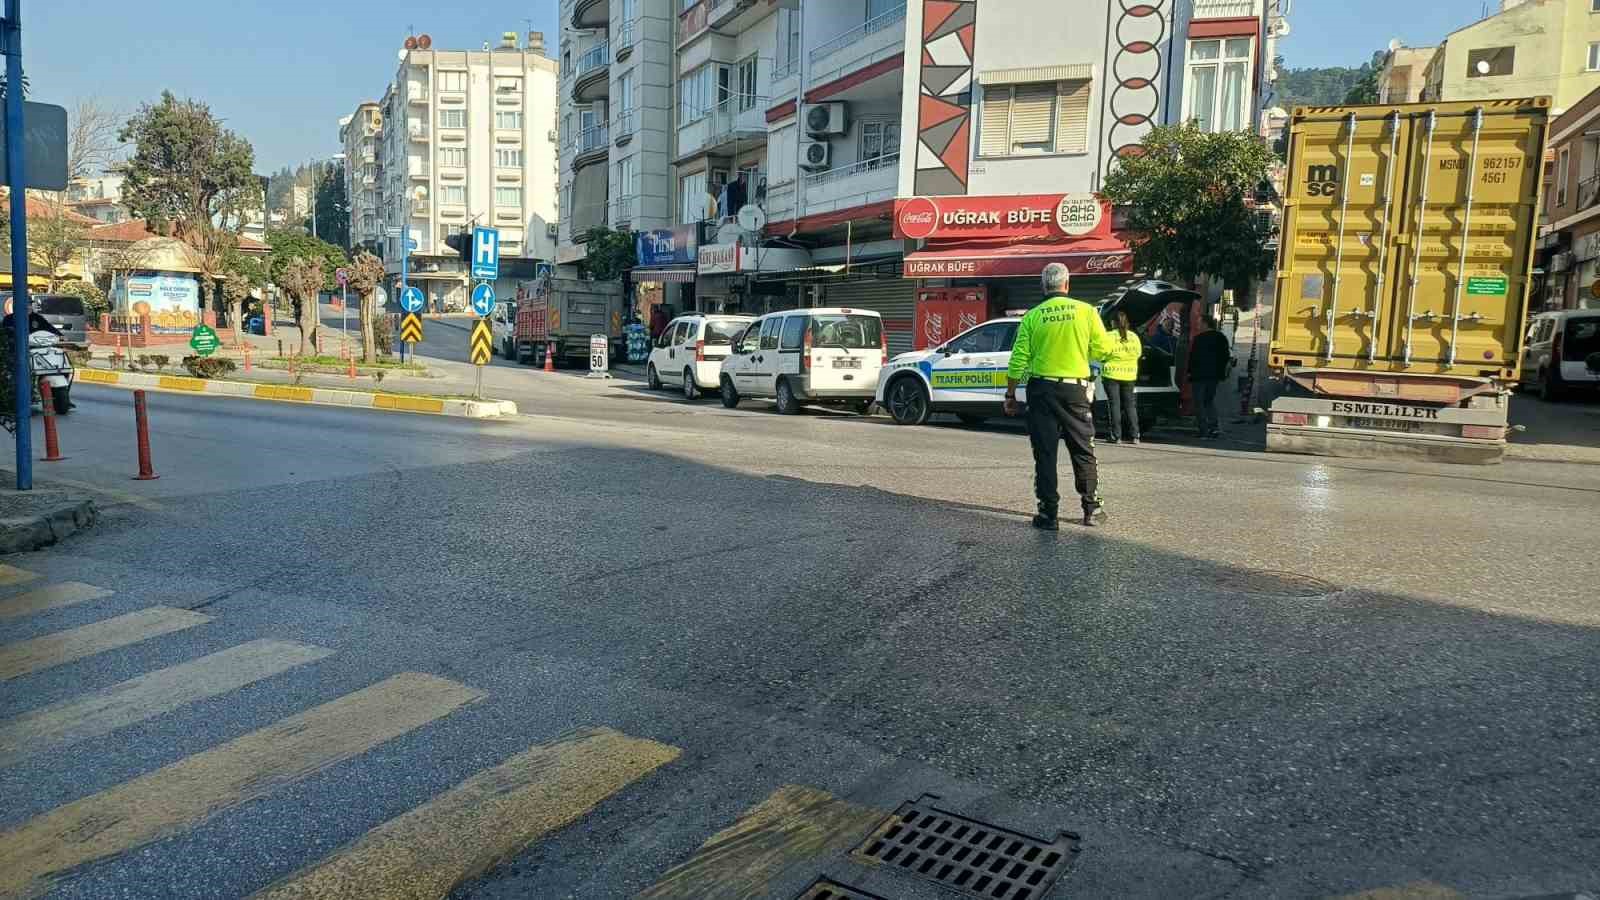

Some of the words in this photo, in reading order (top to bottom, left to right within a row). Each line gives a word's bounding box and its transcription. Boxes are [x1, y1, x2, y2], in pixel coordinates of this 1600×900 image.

[1483, 157, 1521, 169] 962157
[1481, 172, 1506, 184] 45G1
[1061, 204, 1096, 214] DAHA
[943, 208, 1001, 225] UĞRAK
[1007, 207, 1053, 224] BÜFE
[1061, 213, 1095, 223] DAHA
[476, 231, 495, 265] H
[909, 261, 946, 273] UĞRAK
[947, 260, 976, 272] BÜFE
[592, 355, 603, 367] 50
